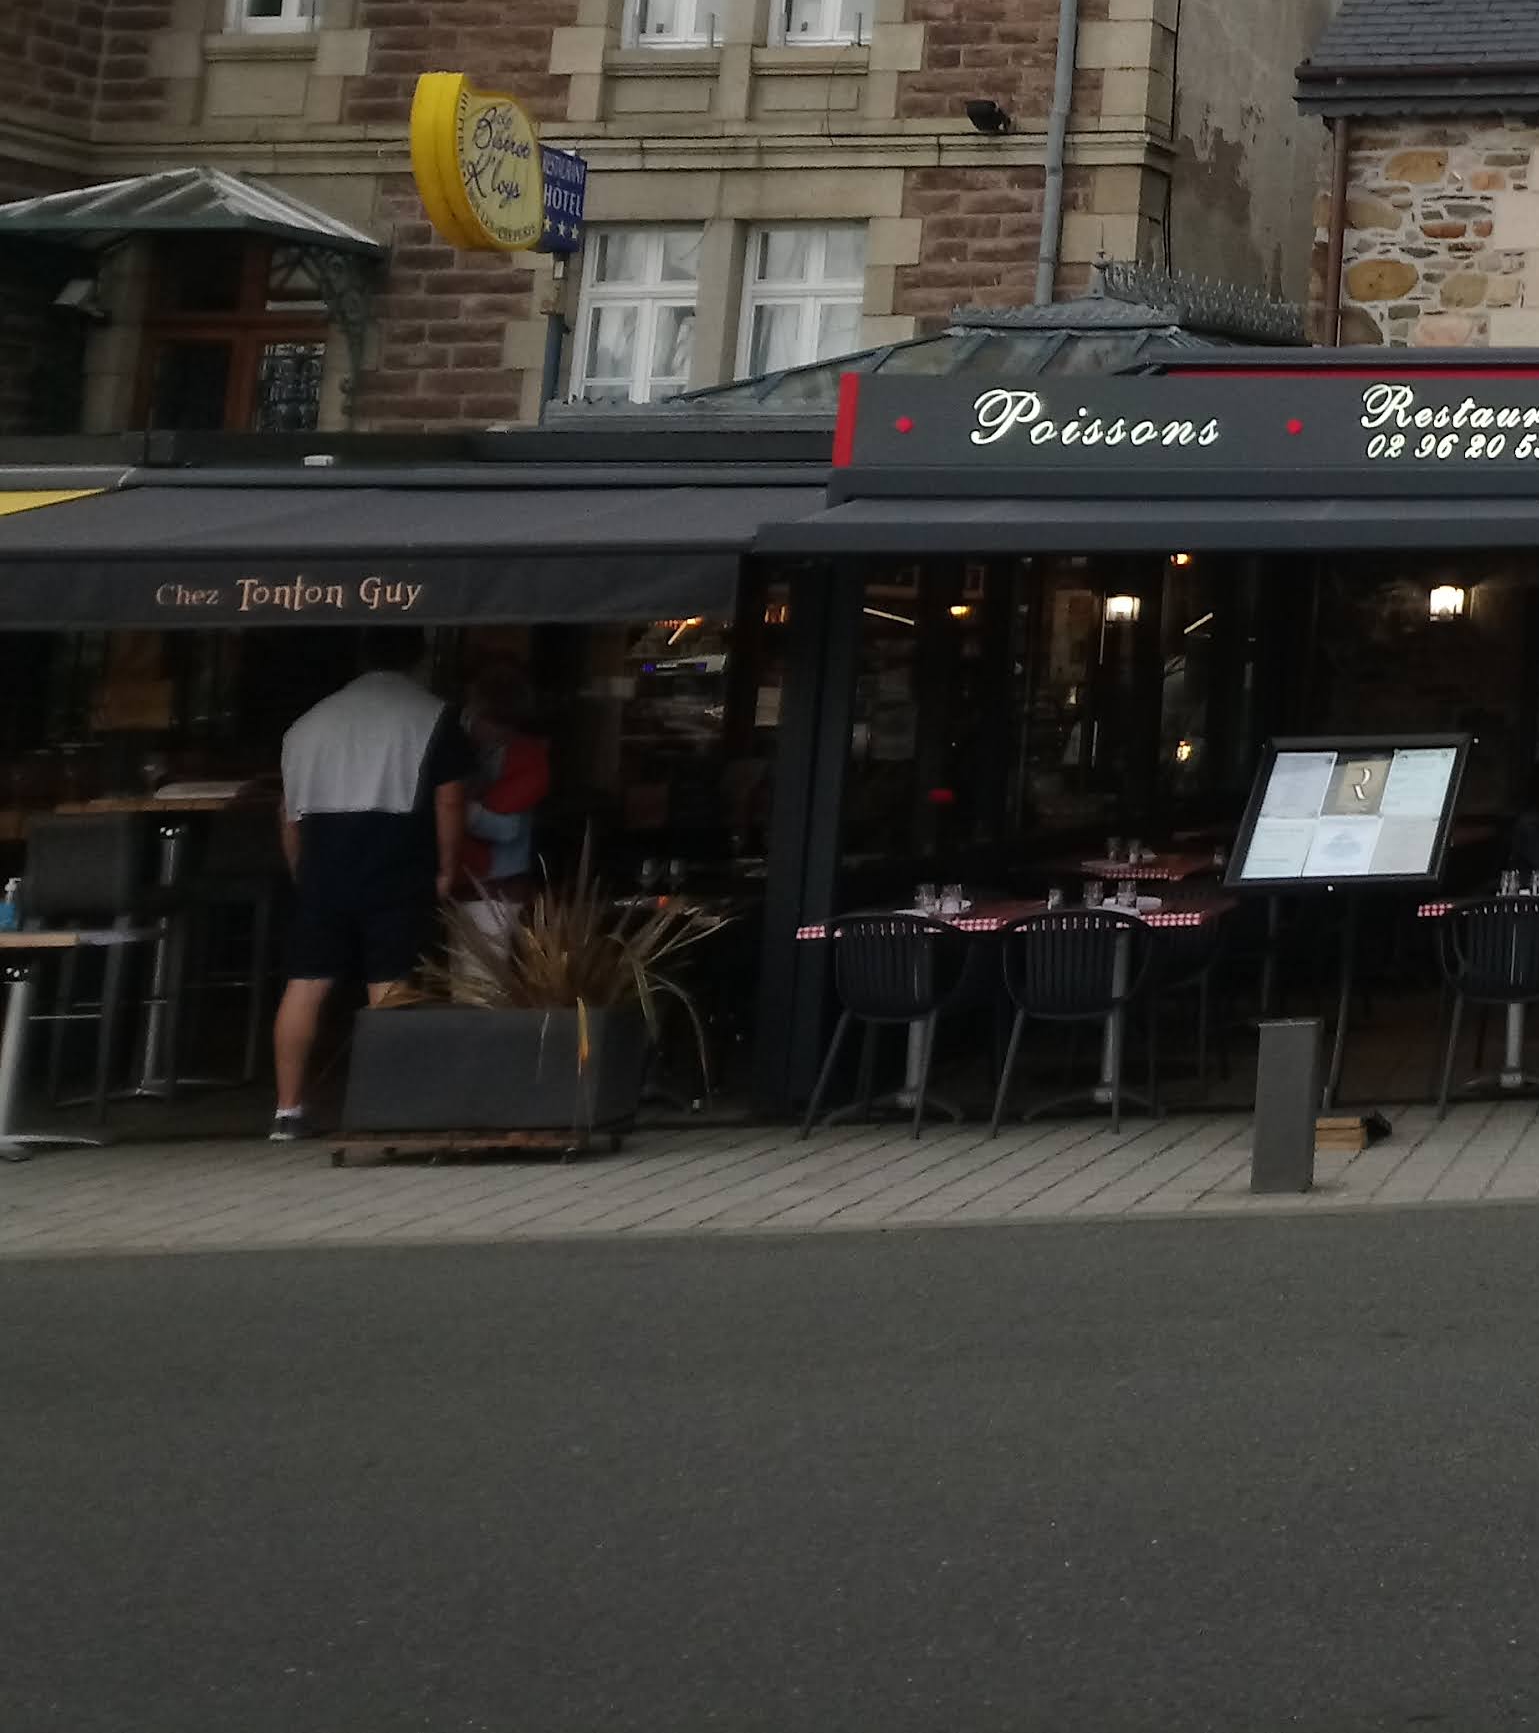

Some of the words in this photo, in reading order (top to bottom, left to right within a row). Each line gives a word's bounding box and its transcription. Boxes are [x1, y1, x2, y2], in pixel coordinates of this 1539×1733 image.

[970, 389, 1219, 445] Poissons
[1367, 433, 1406, 458] 02
[1415, 433, 1458, 458] 96
[1464, 433, 1505, 458] 20
[155, 582, 220, 606] Chez
[236, 575, 344, 611] Tonton
[358, 576, 423, 610] Guy
